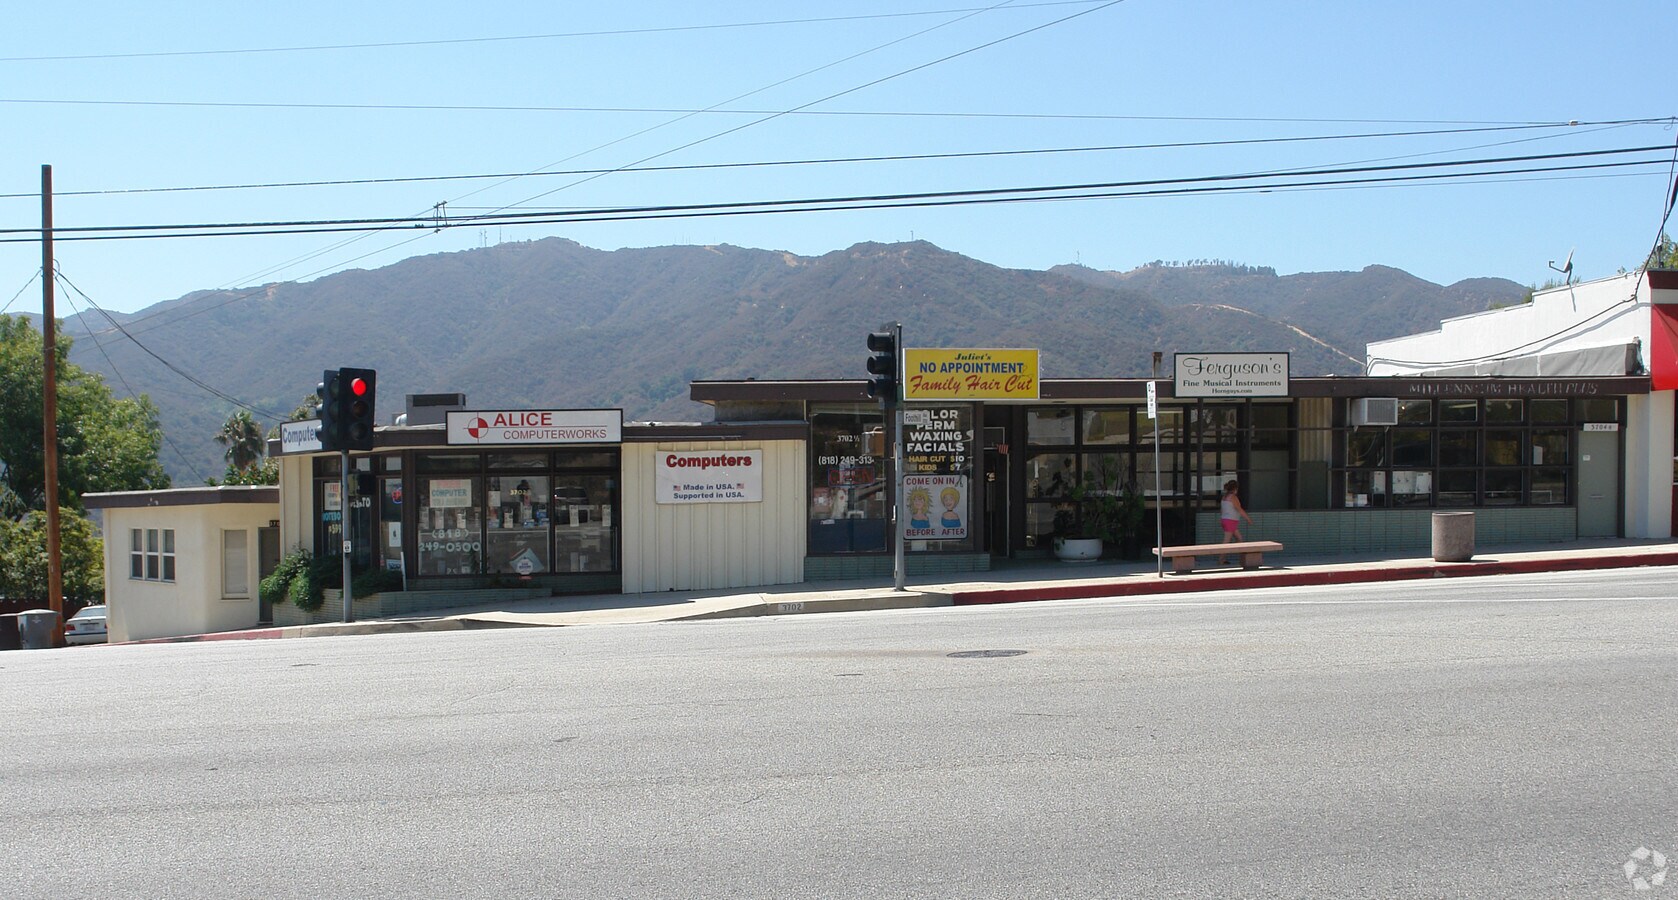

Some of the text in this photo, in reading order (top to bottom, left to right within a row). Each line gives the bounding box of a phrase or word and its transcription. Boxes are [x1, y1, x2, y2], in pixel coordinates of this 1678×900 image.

[955, 353, 991, 361] Juliet's
[919, 362, 1024, 373] NO APPOINTMENT
[1183, 357, 1282, 380] Ferguson's
[910, 374, 1033, 394] Family Hair Cut
[1235, 379, 1281, 387] Instruments
[1508, 382, 1563, 395] HEALTH
[1565, 382, 1599, 395] PLUS
[493, 412, 553, 426] ALICE
[503, 429, 607, 441] COMPUTERWORKS
[909, 431, 962, 441] WAXING
[906, 442, 965, 452] FACIALS
[666, 454, 752, 470] Computers
[818, 456, 838, 465] (818)
[950, 463, 961, 471] $7
[906, 477, 955, 485] COME ON IN
[673, 492, 714, 502] Supported
[432, 529, 469, 539] (818)
[906, 528, 965, 537] BEFORE AFTER
[418, 541, 481, 553] 249-0500
[782, 603, 802, 611] 3702
